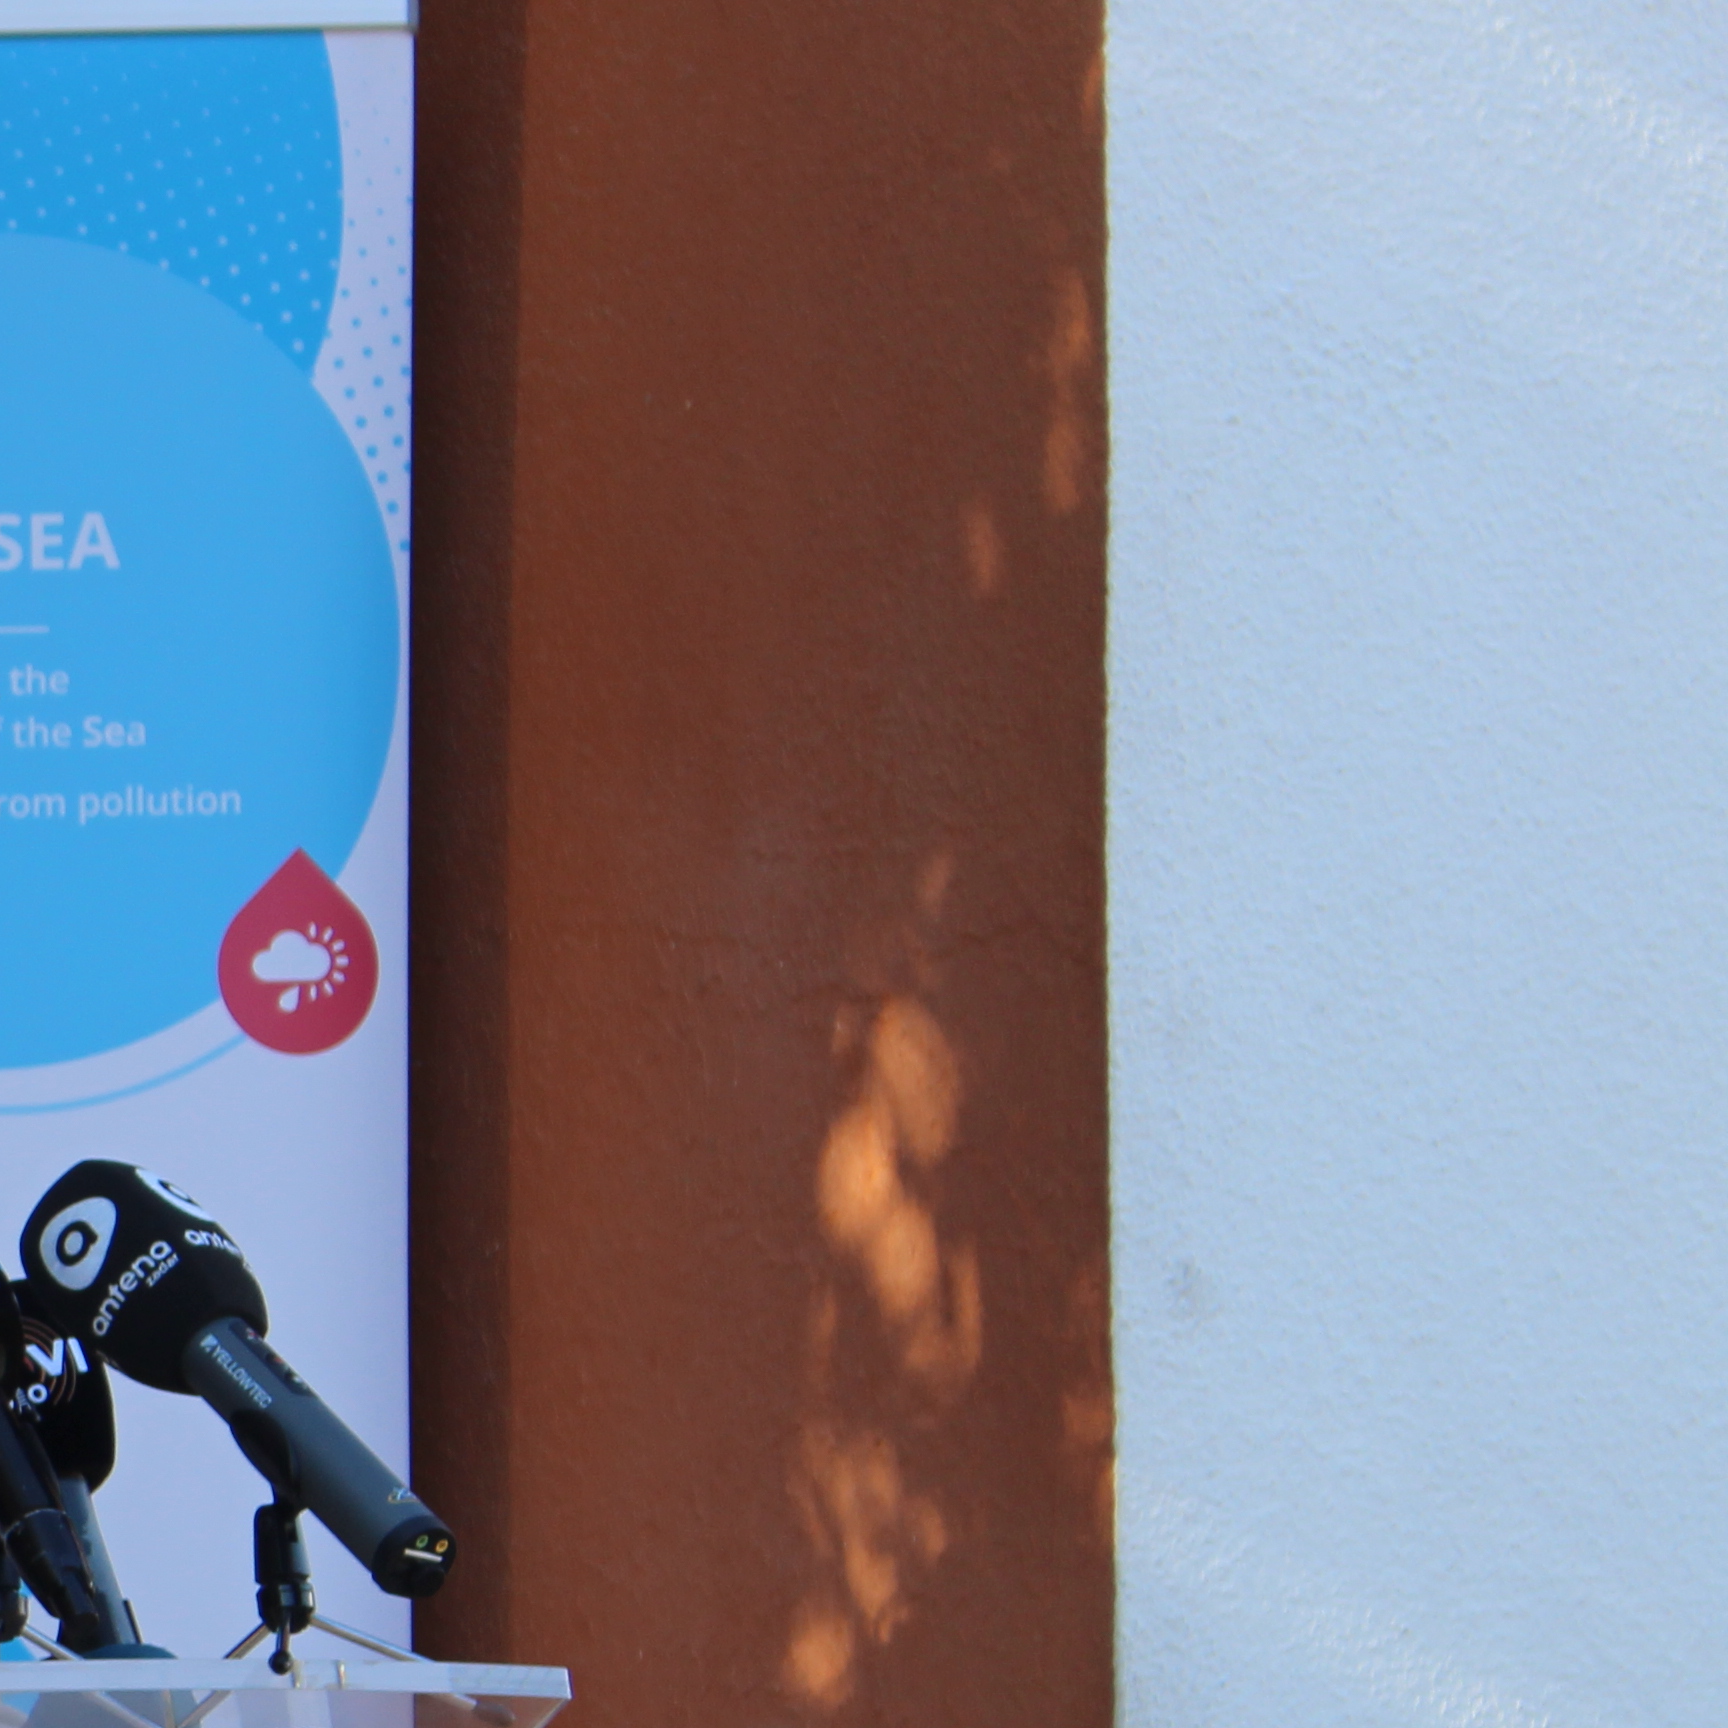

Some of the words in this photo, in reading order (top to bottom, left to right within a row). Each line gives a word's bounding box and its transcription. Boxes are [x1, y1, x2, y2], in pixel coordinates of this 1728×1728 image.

[10, 665, 70, 696] the
[12, 718, 72, 749] the
[82, 715, 146, 748] Sea
[77, 785, 242, 825] pollution
[93, 1240, 173, 1337] antena
[147, 1251, 181, 1288] zadar
[207, 1343, 273, 1410] YELLOWTEC
